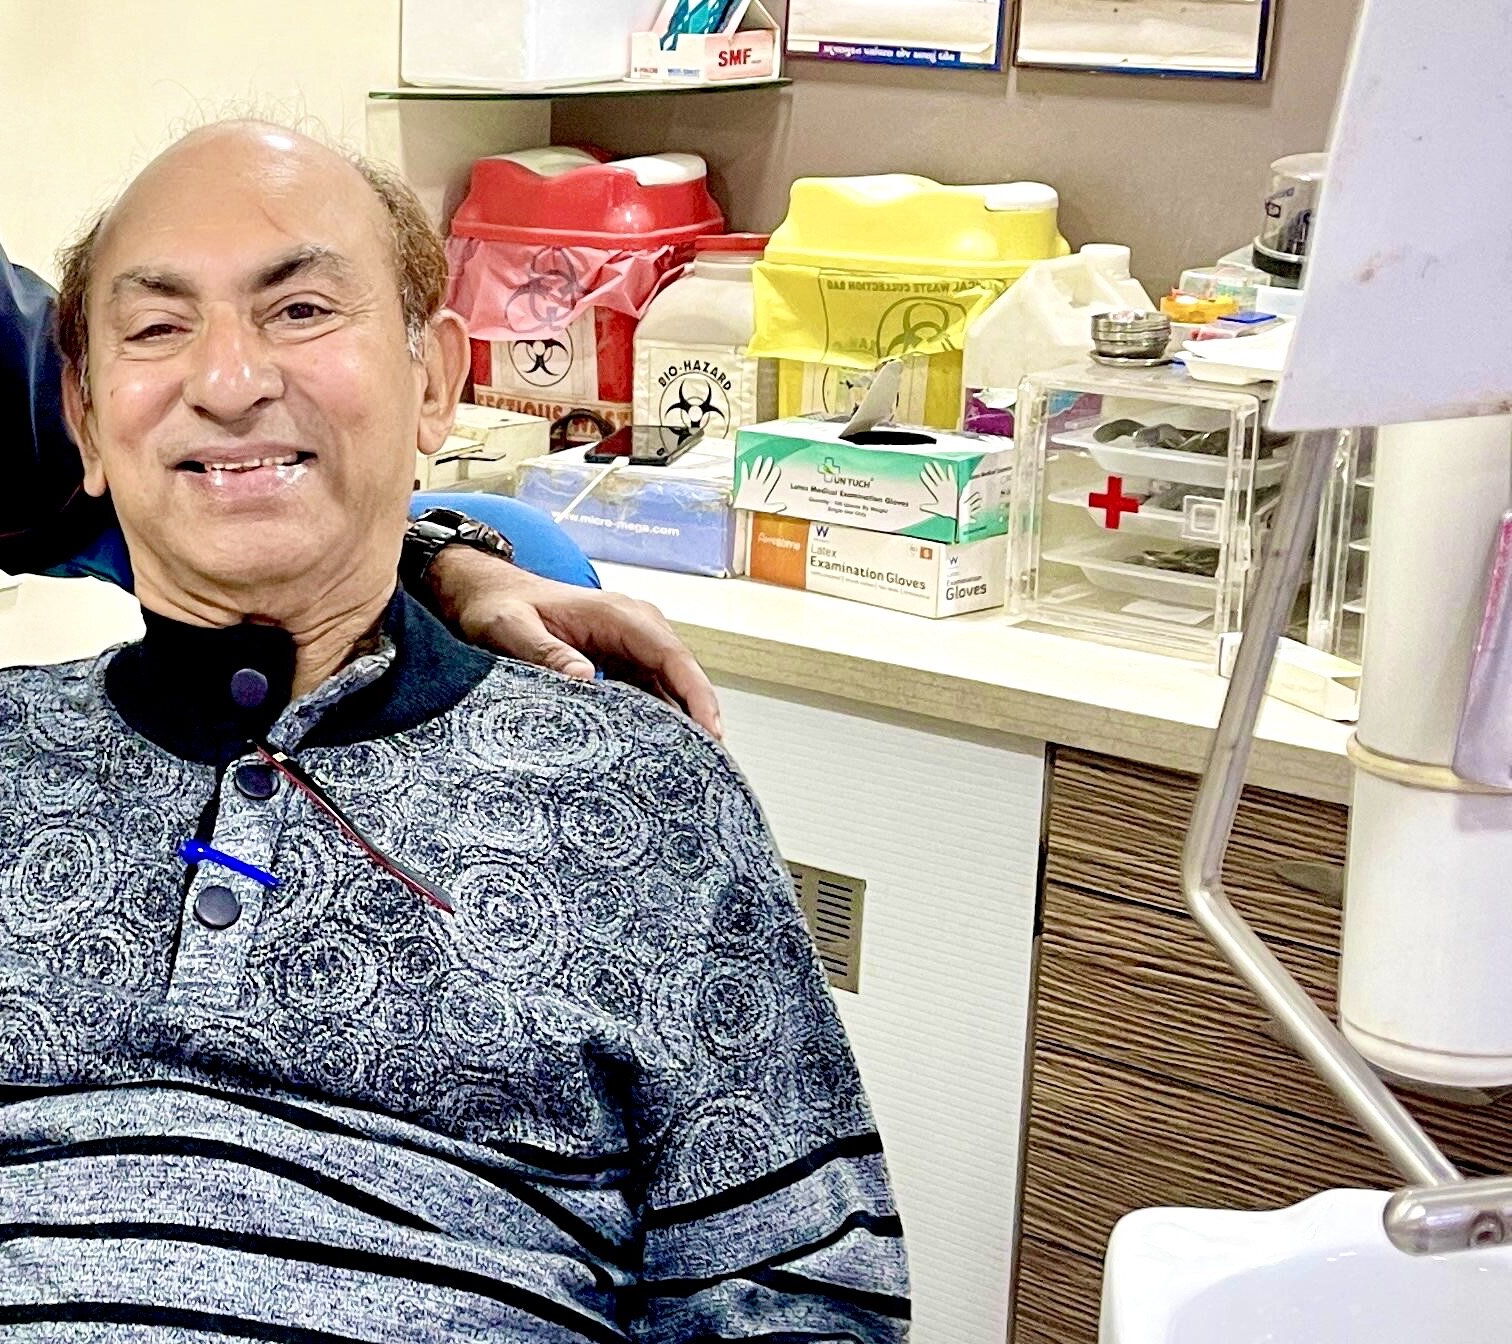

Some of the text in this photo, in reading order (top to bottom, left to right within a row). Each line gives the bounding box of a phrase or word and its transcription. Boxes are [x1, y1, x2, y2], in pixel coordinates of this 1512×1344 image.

[718, 47, 752, 68] SMF
[658, 359, 732, 392] BIO-HAZARD
[810, 485, 838, 496] Medical
[839, 490, 883, 503] Examination
[884, 497, 909, 508] Gloves
[551, 511, 681, 537] ww.micro-mega.com
[815, 524, 829, 539] W
[810, 543, 838, 559] Latex
[809, 555, 884, 582] Examination
[886, 572, 926, 591] Gloves
[945, 583, 988, 602] Gloves
